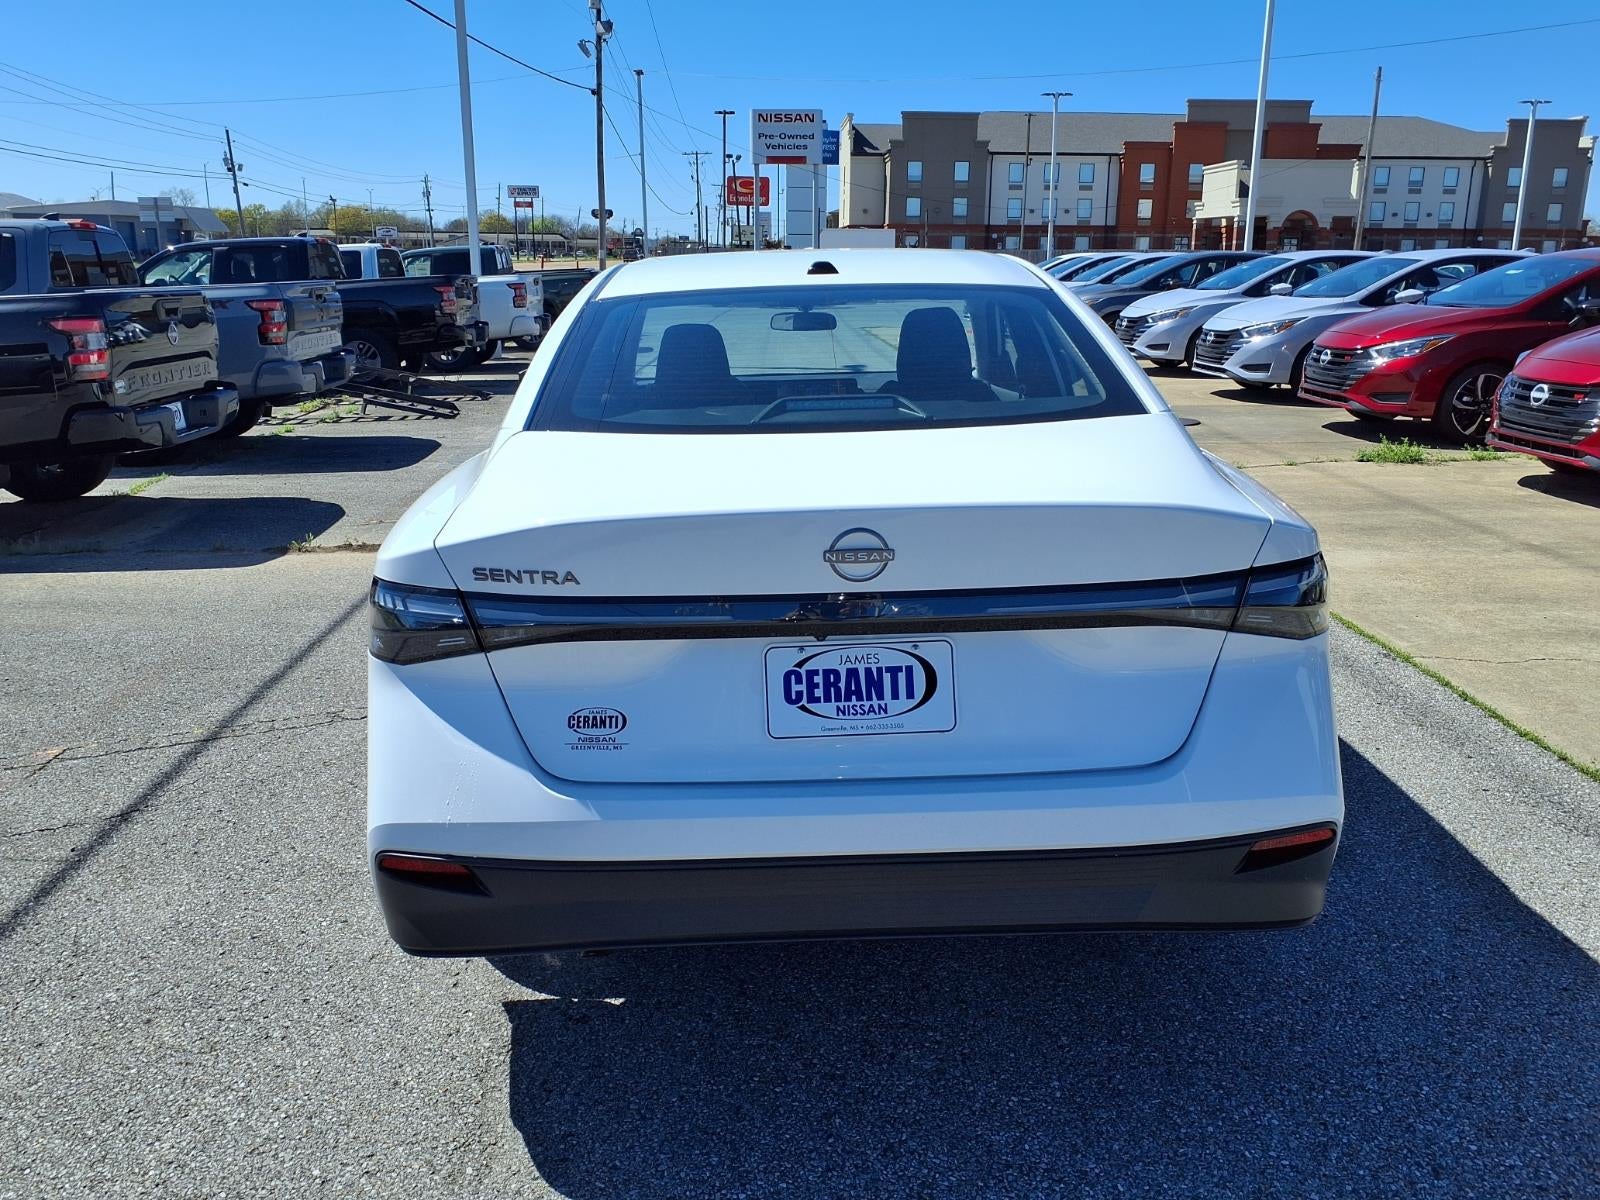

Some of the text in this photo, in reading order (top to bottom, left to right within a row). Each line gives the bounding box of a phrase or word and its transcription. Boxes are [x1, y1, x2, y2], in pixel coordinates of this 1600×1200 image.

[758, 113, 815, 123] NISSAN
[758, 132, 815, 140] Pre-Owned
[294, 332, 340, 353] FRONTIER
[126, 361, 212, 390] FRONTIER
[825, 550, 893, 563] NISSAN
[472, 566, 580, 585] SENTRA
[838, 652, 881, 666] JAMES
[783, 665, 916, 706] CERANTI
[836, 702, 889, 717] NISSAN
[567, 714, 619, 730] CERANTI
